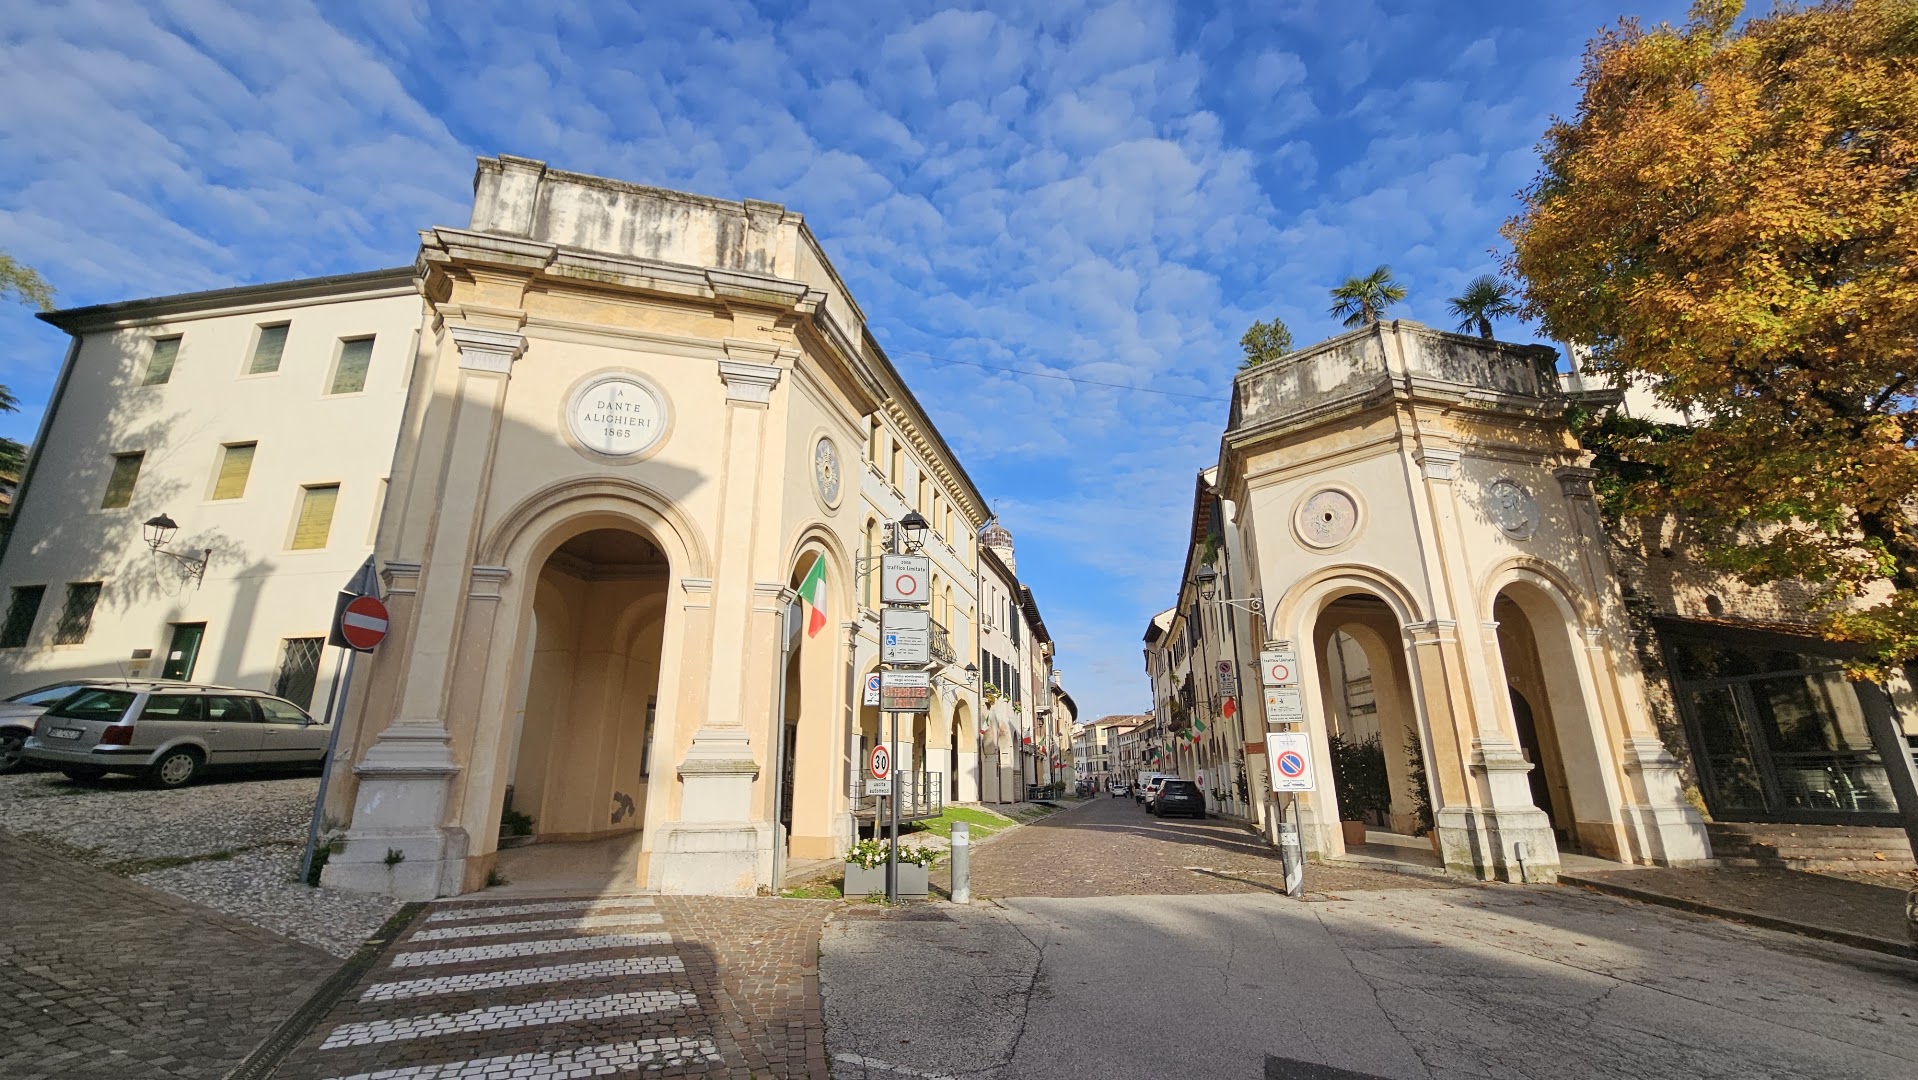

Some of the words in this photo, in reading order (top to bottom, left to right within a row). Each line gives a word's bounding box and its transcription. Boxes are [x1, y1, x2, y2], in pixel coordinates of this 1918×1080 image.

[617, 389, 624, 397] A
[597, 400, 641, 413] DANTE
[584, 413, 651, 428] ALIGHIERI
[604, 427, 631, 438] 1865
[875, 755, 886, 770] 30
